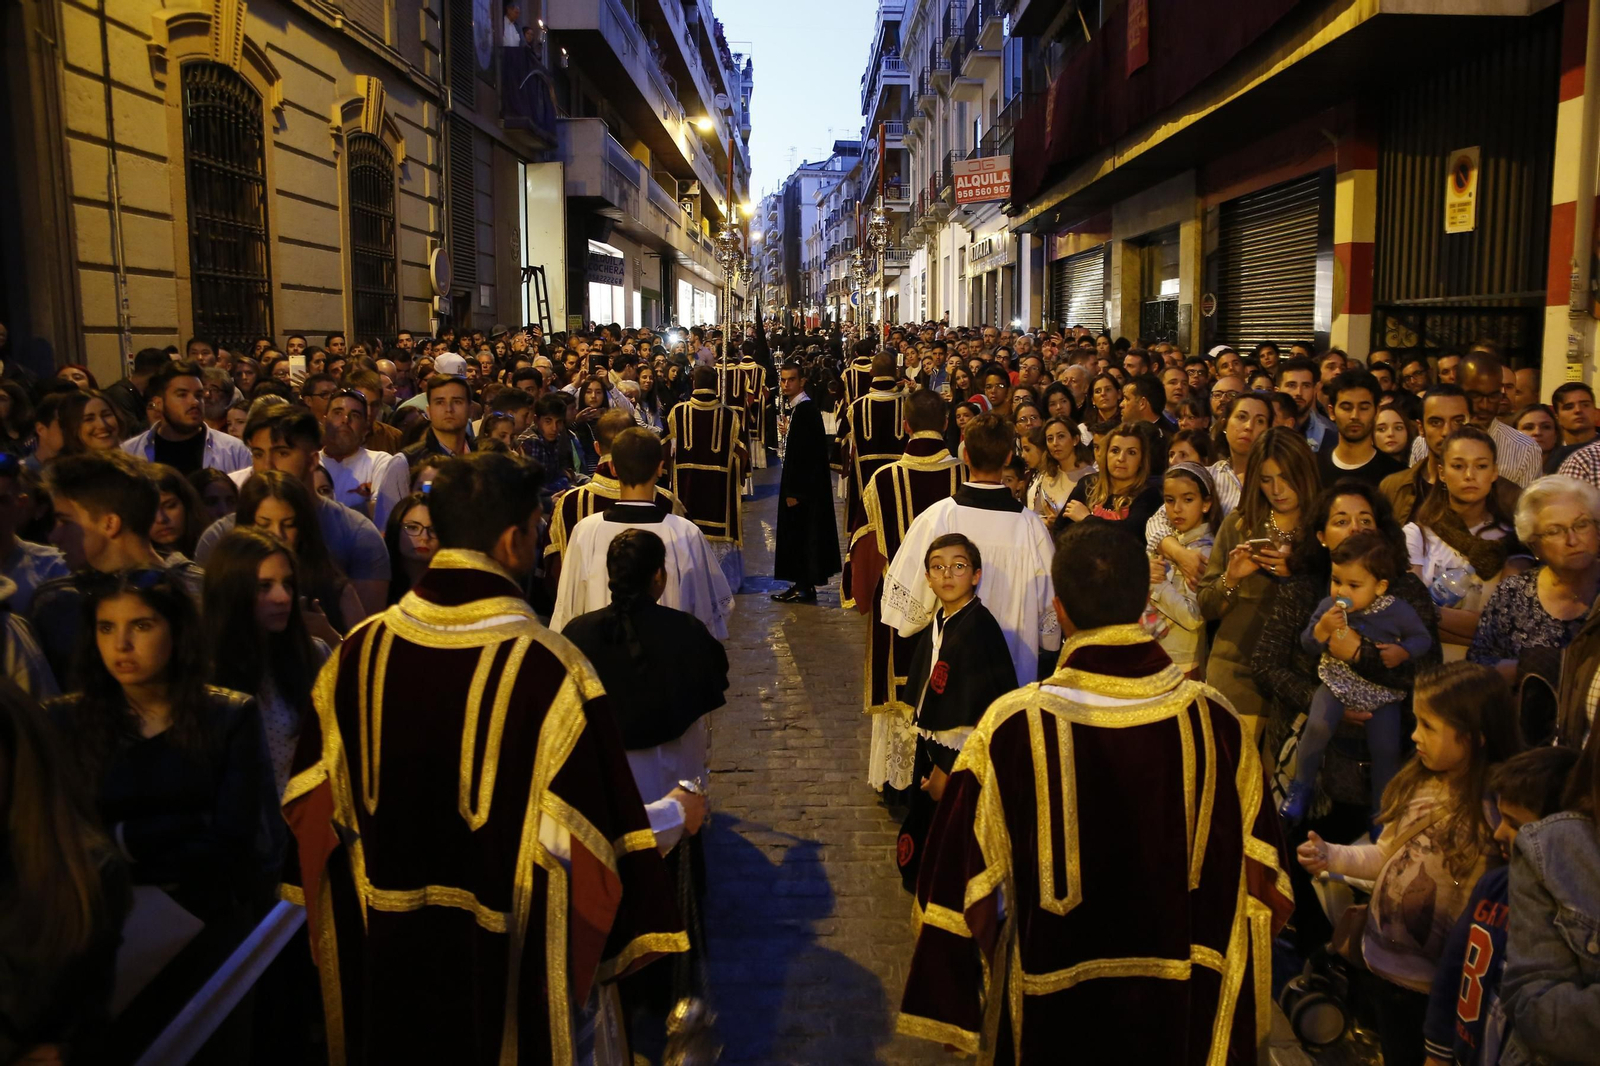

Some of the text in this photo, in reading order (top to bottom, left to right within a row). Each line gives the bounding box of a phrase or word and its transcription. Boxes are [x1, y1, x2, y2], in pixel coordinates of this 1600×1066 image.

[957, 171, 1010, 189] ALQUILA
[957, 189, 974, 199] 958
[975, 187, 992, 197] 560
